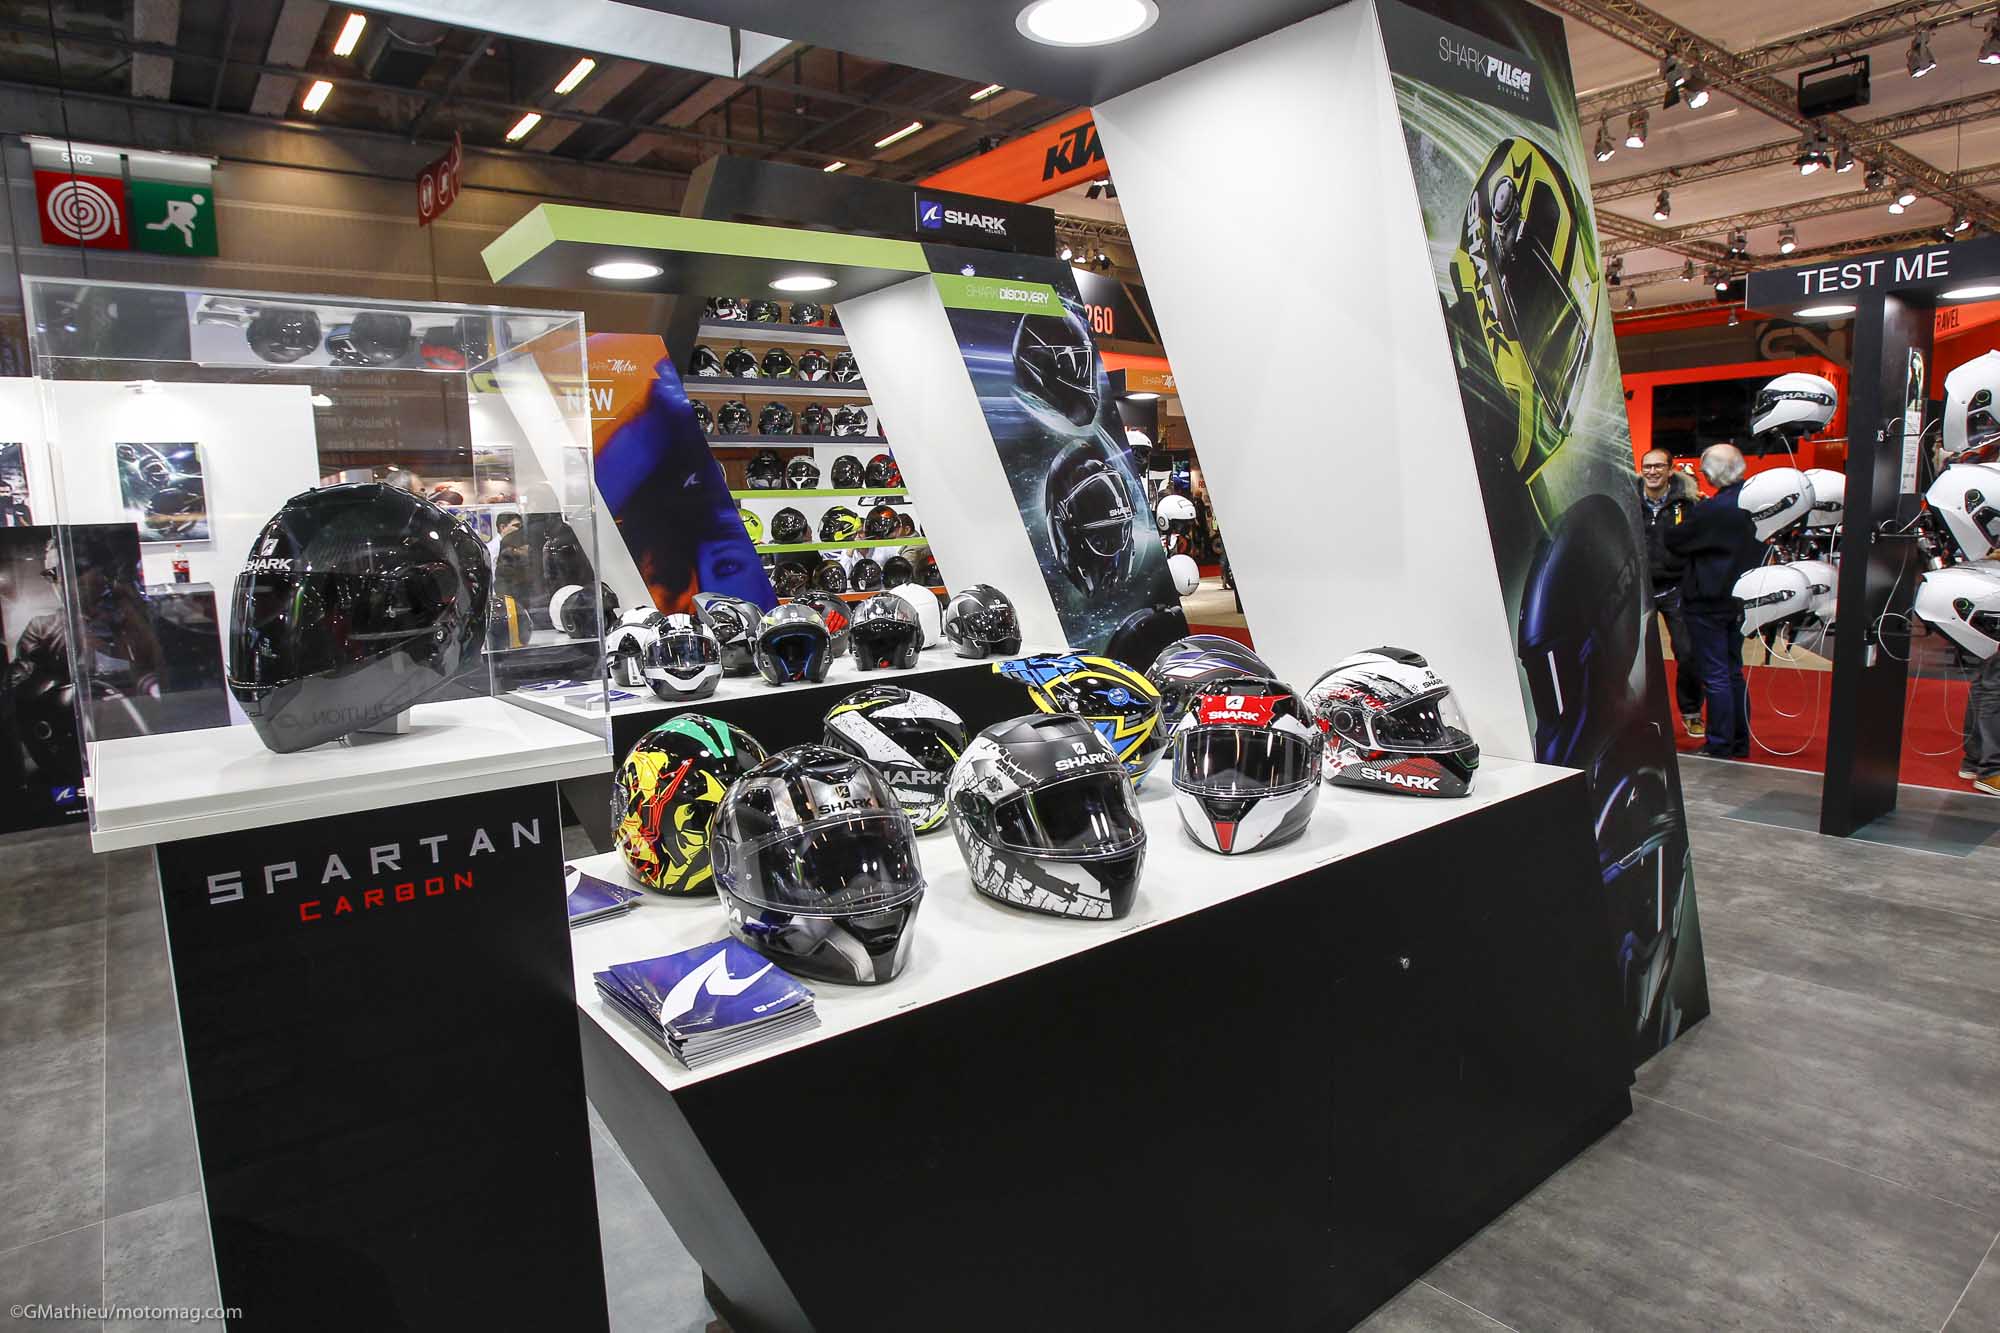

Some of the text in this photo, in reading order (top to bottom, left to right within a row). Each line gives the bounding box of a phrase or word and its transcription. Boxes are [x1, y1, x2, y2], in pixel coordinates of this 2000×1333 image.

[944, 210, 1007, 231] SHARK
[1467, 190, 1513, 366] SHARK
[1797, 250, 1950, 295] TEST ME
[1207, 710, 1260, 722] SHARK
[1055, 752, 1110, 772] SHARK
[883, 769, 948, 785] ARK
[1361, 767, 1441, 791] SHARK
[820, 797, 875, 815] SHARK
[206, 817, 542, 905] SPARTAN
[299, 870, 475, 922] CARBON
